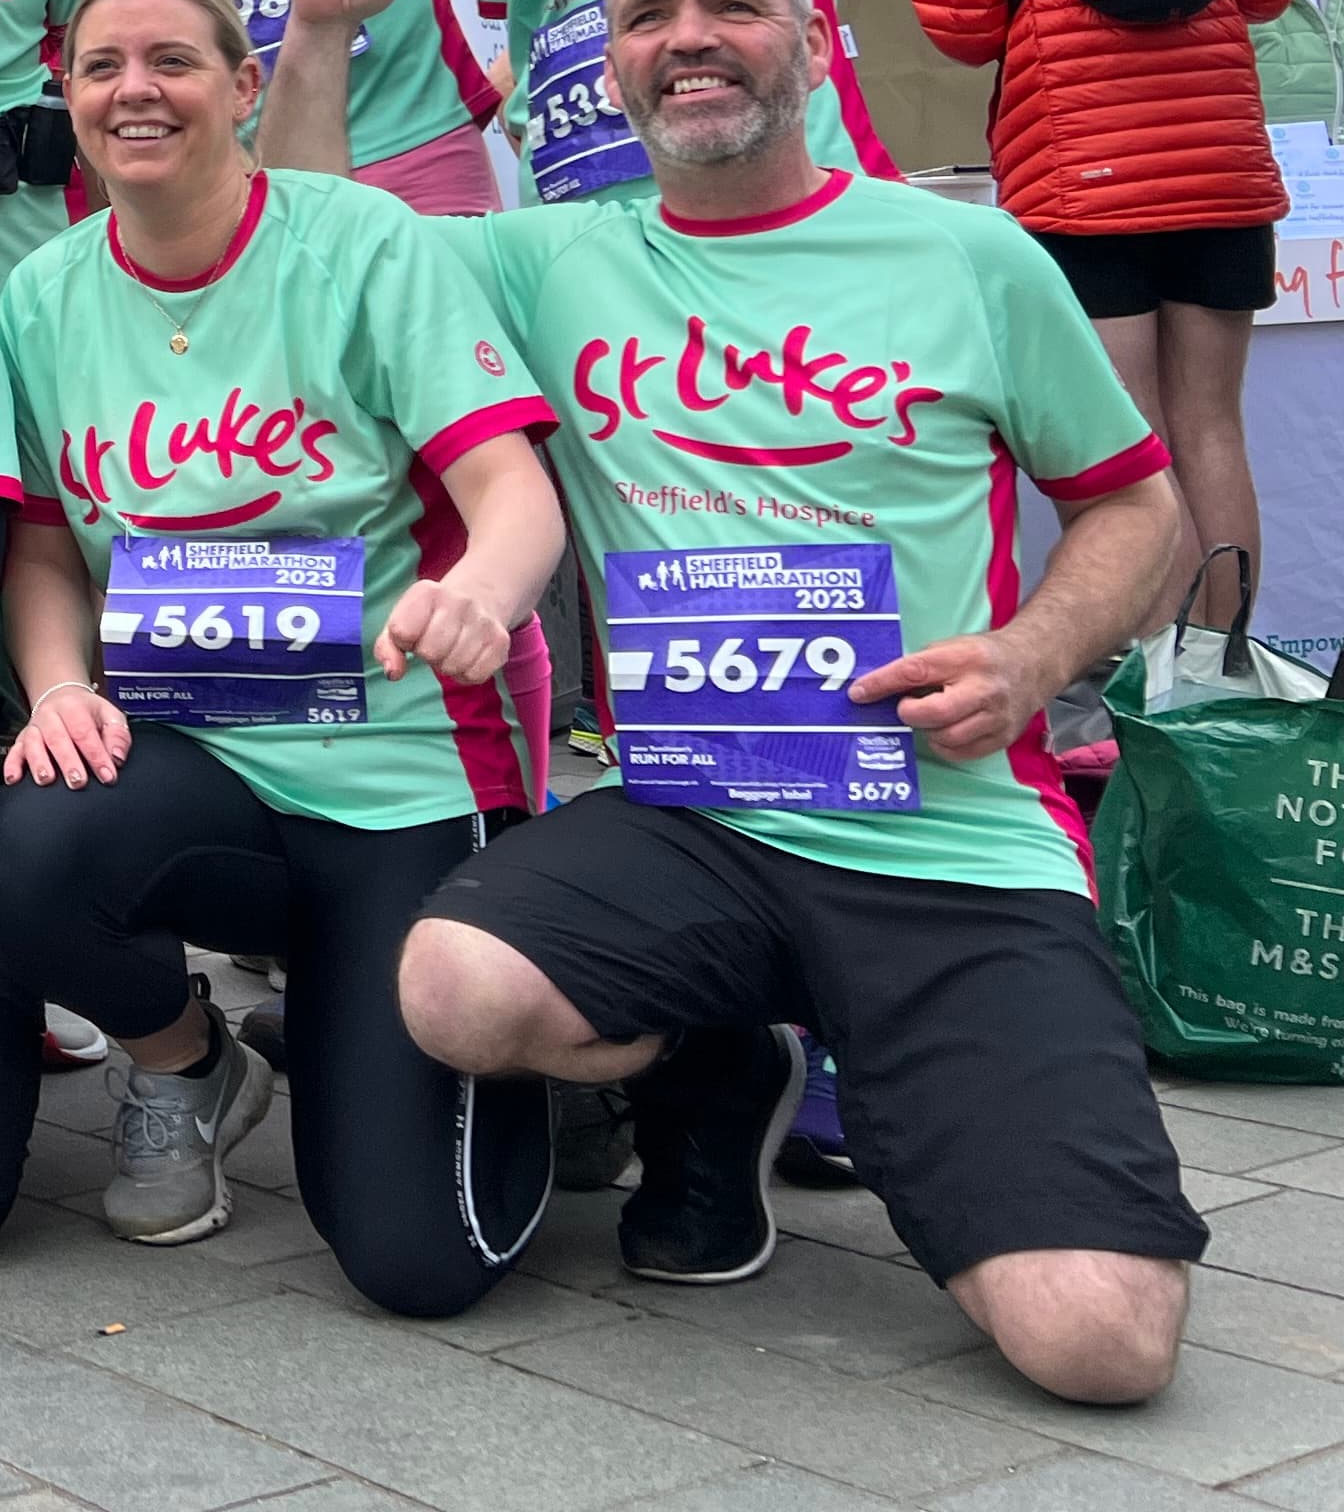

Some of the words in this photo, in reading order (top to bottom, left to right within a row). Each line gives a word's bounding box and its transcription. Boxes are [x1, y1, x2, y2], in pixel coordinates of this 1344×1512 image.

[573, 336, 666, 442] St
[676, 315, 944, 447] Luke's
[128, 387, 338, 490] Luke's
[613, 481, 747, 517] Sheffield's
[757, 496, 876, 528] Hospice
[189, 544, 267, 555] SHEFFIELD
[187, 556, 229, 569] HALF
[232, 556, 333, 569] MARATHON
[690, 555, 779, 571] SHEFFIELD
[275, 569, 336, 587] 2023
[689, 573, 738, 588] HALF
[742, 571, 859, 586] MARATHON
[795, 589, 865, 610] 2023
[149, 605, 321, 652] 5619
[665, 636, 856, 693] 5679
[118, 690, 145, 701] RUN
[147, 690, 170, 700] FOR
[172, 690, 194, 701] ALL
[307, 708, 361, 723] 5619
[630, 753, 659, 765] RUN
[661, 753, 689, 765] FOR
[690, 753, 717, 766] ALL
[848, 782, 911, 801] 5679
[1250, 940, 1341, 981] M&S
[1178, 984, 1209, 1003] This
[1215, 993, 1247, 1015] bag
[1253, 1002, 1266, 1017] is
[1274, 1009, 1316, 1026] made
